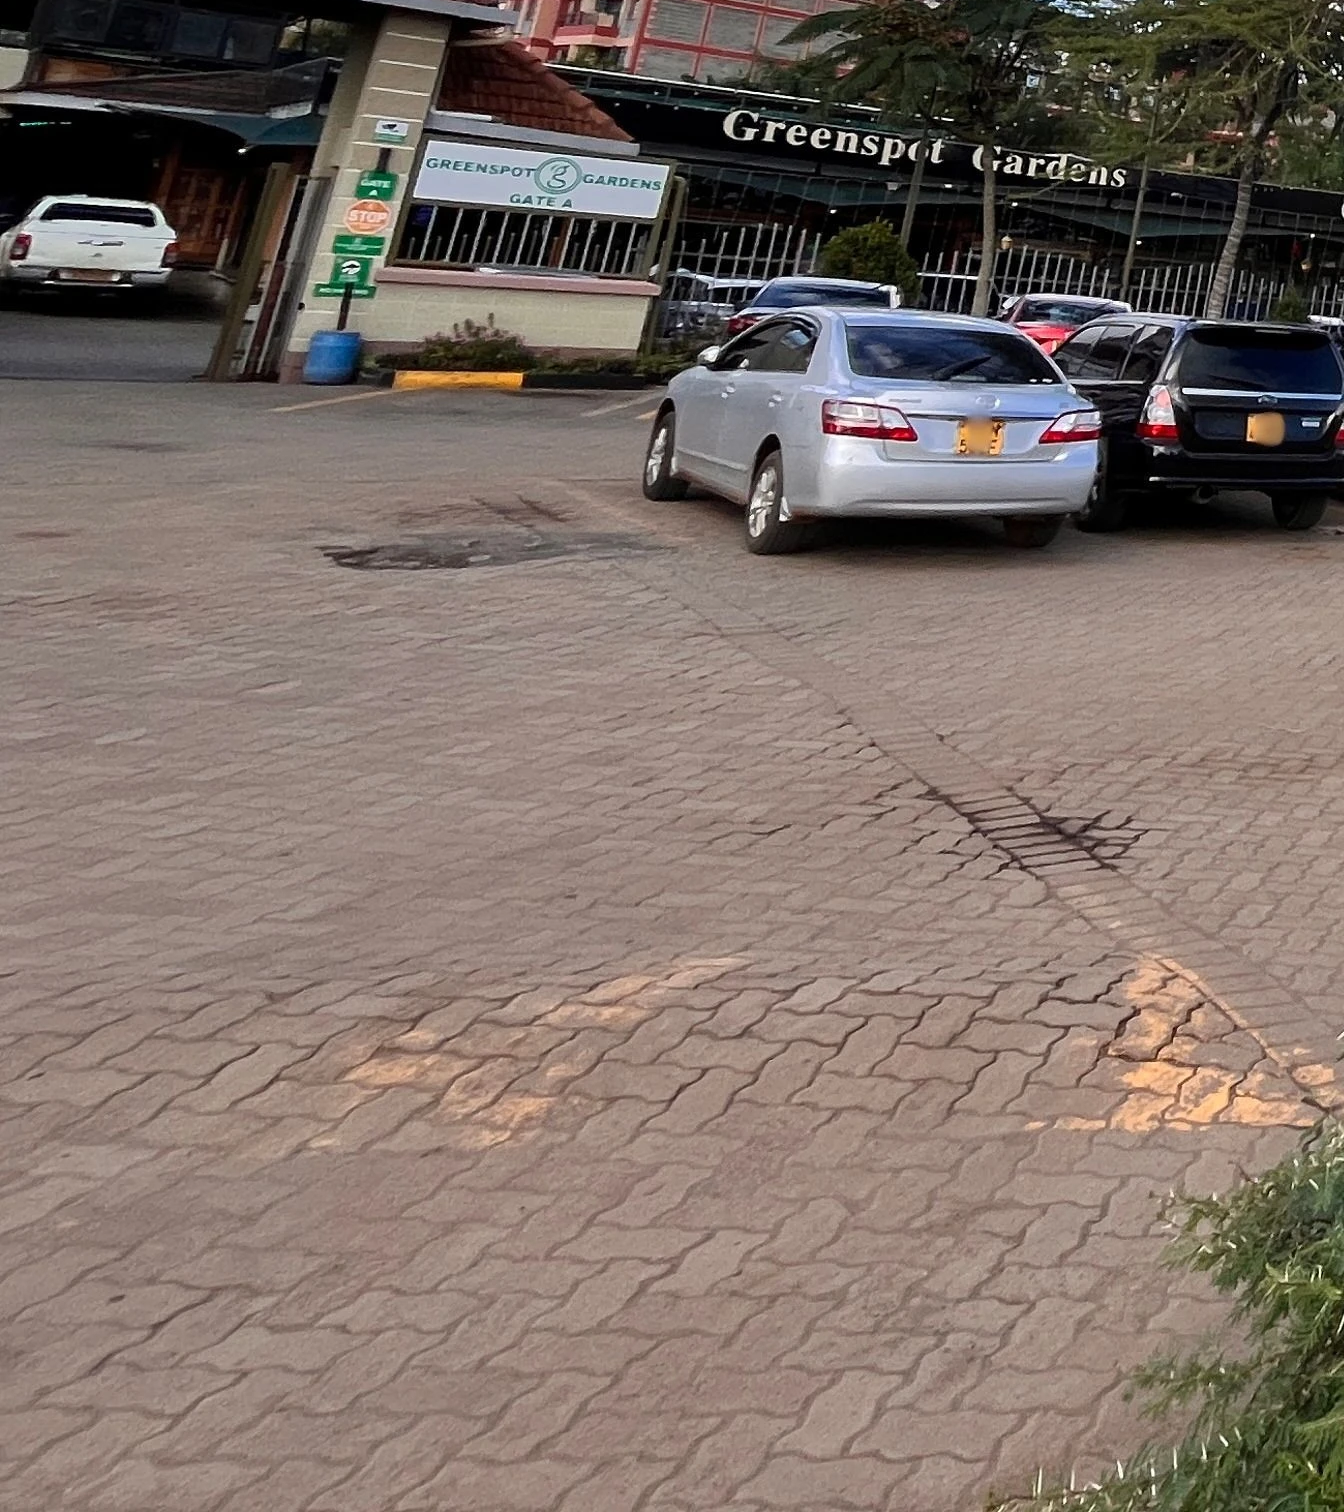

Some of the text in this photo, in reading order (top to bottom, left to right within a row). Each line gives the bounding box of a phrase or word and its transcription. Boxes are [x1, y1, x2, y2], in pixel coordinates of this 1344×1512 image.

[723, 109, 1128, 188] Greenspot Gardens
[426, 157, 537, 178] GREENSPOT
[360, 178, 391, 189] GATE
[582, 174, 662, 191] GARDENS
[509, 193, 574, 209] GATE A
[347, 209, 388, 224] STOP
